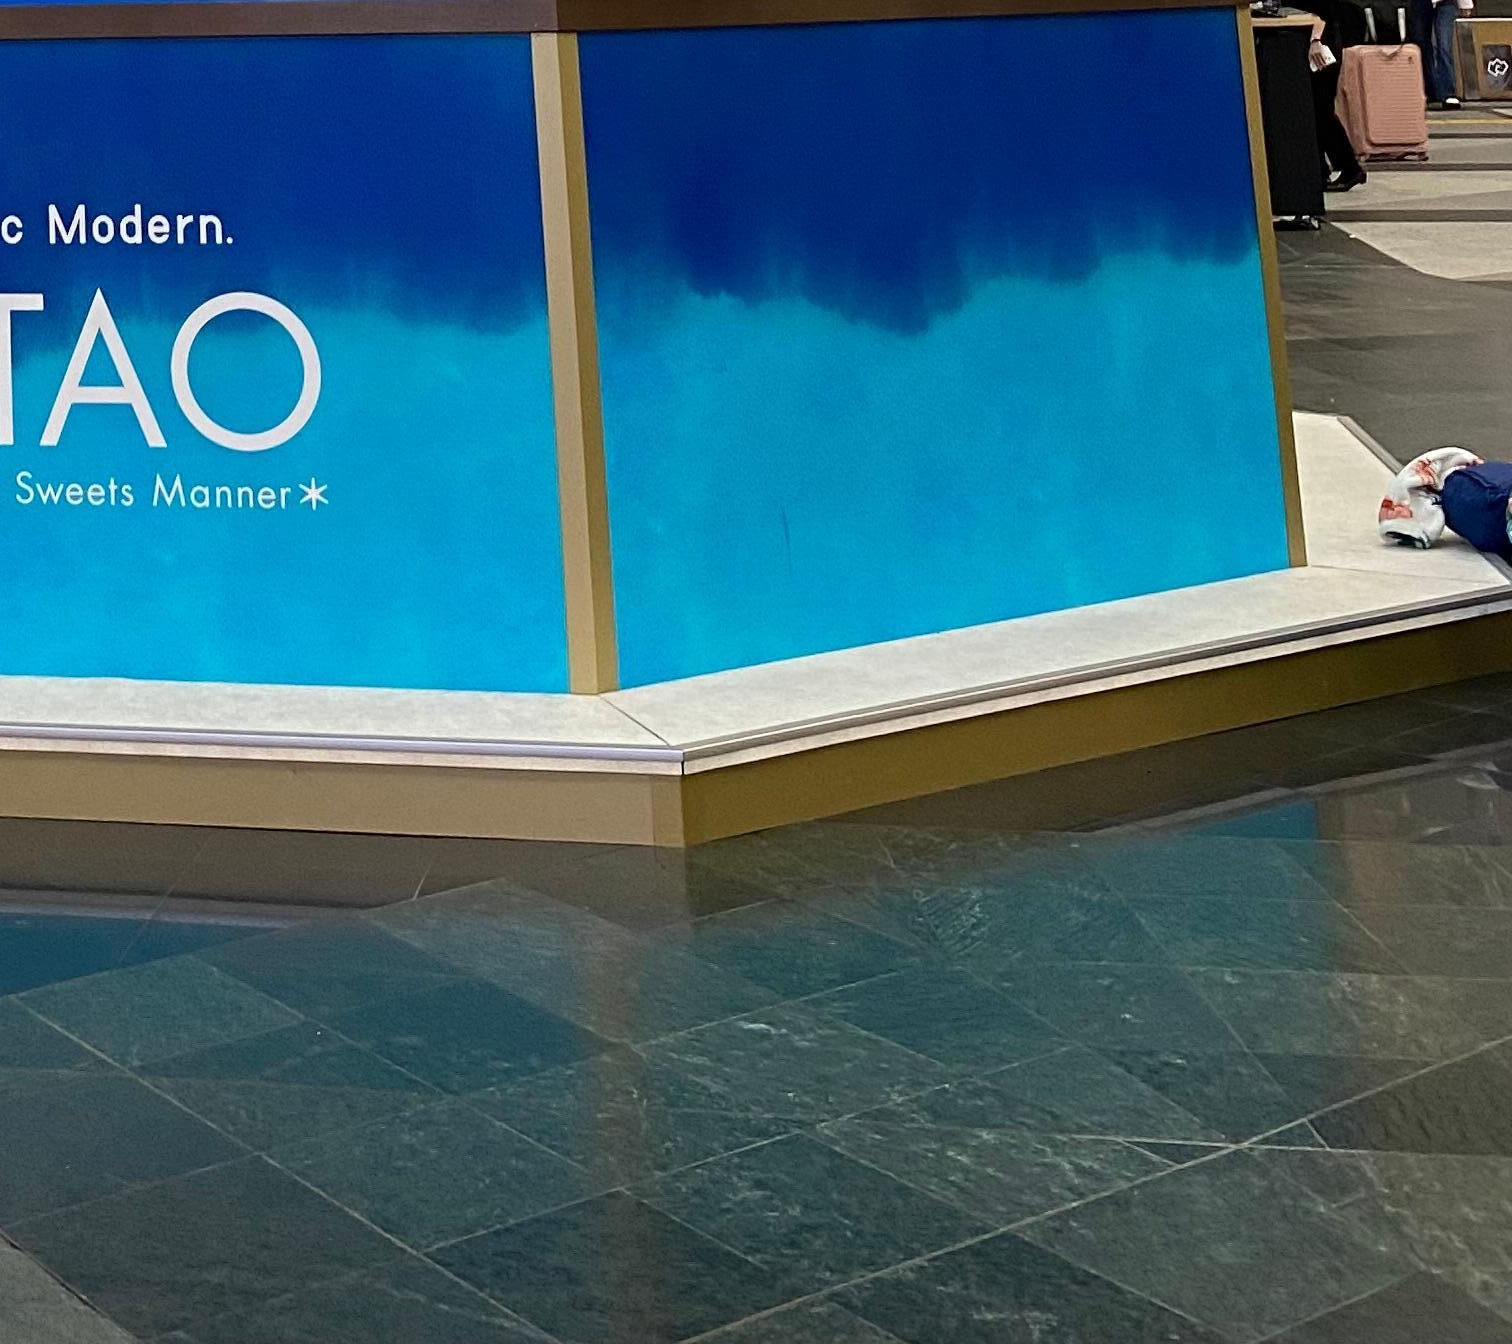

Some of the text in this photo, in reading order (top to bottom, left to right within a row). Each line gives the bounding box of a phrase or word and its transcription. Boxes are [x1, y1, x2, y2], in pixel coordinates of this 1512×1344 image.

[48, 203, 234, 245] Modern.
[15, 471, 135, 507] Sweets
[152, 473, 291, 510] Manner
